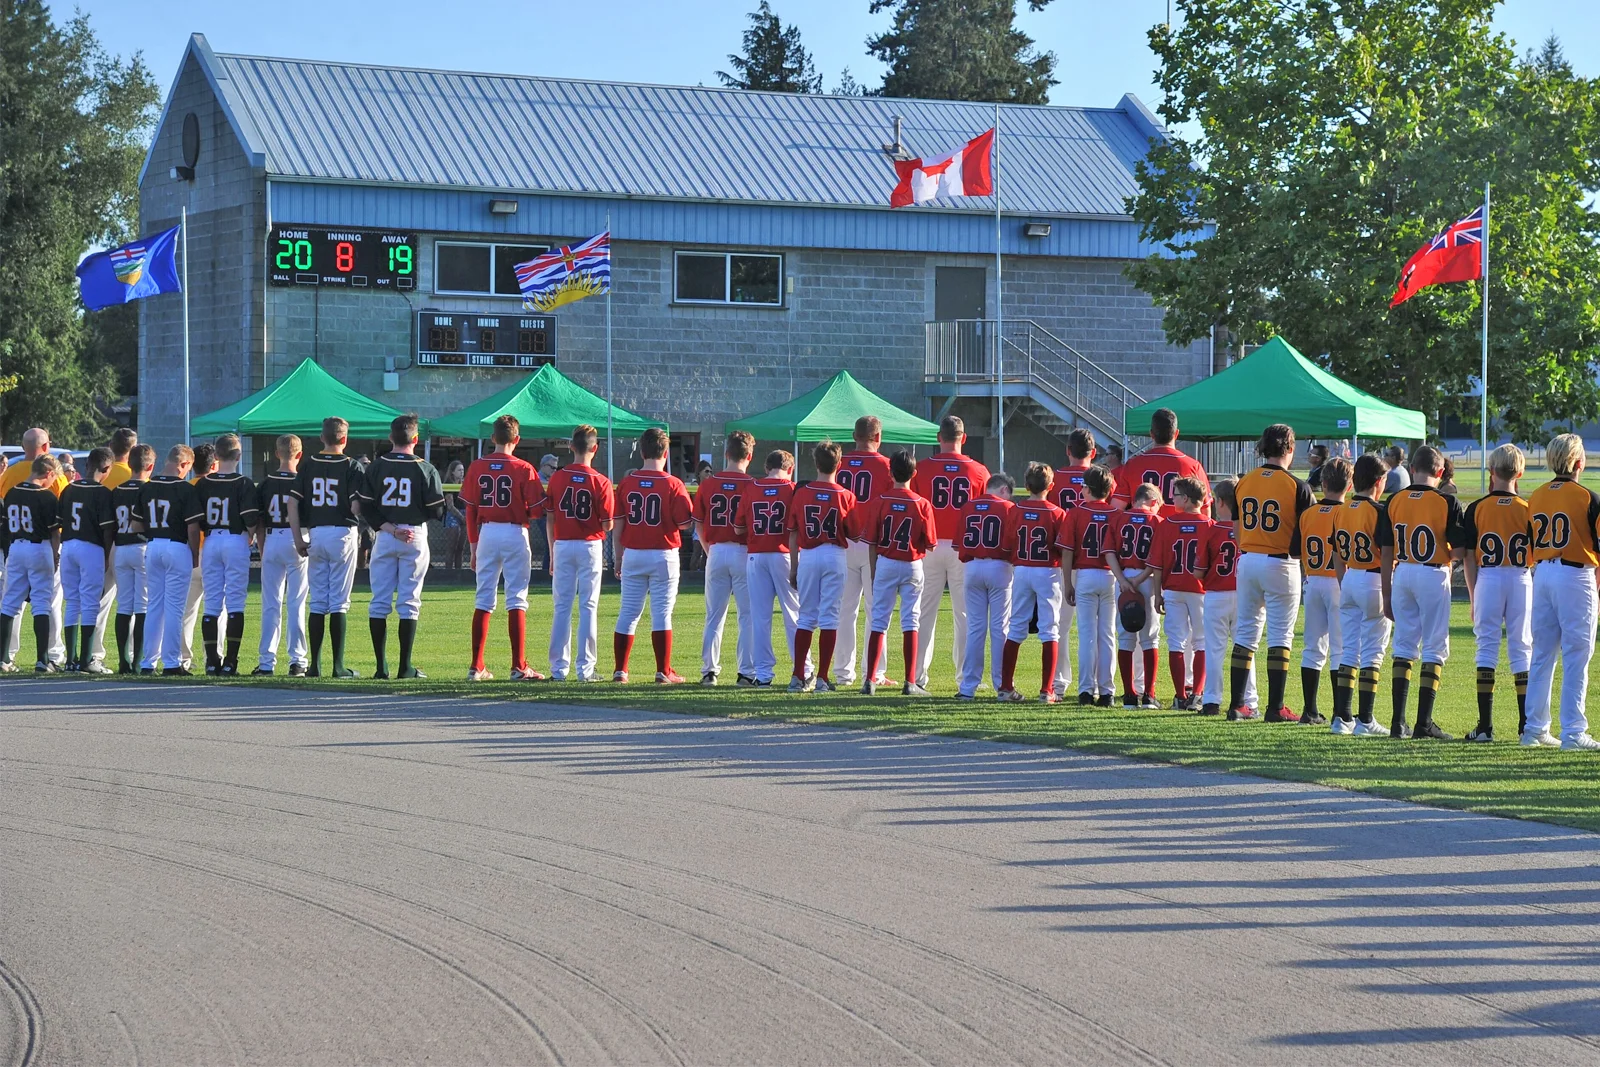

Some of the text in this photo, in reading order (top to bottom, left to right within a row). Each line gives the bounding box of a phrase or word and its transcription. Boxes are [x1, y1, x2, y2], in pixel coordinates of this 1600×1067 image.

[279, 231, 309, 239] HOME
[327, 233, 362, 242] INNING
[276, 240, 412, 274] 20 8 19
[434, 316, 545, 329] HOME INNING GUESTS
[421, 354, 533, 366] BALL STRIKE OUT
[311, 477, 339, 507] 95
[381, 476, 412, 508] 29
[478, 474, 513, 508] 26
[559, 486, 592, 521] 48
[931, 475, 971, 510] 66
[7, 504, 34, 533] 88
[71, 502, 84, 531] 5
[148, 499, 171, 528] 17
[206, 497, 230, 526] 61
[626, 491, 662, 527] 30
[752, 501, 787, 536] 52
[804, 504, 838, 540] 54
[1241, 497, 1281, 533] 86
[878, 514, 913, 552] 14
[963, 515, 1001, 549] 50
[1016, 525, 1050, 561] 12
[1120, 523, 1154, 560] 36
[1393, 523, 1437, 564] 10
[1532, 511, 1571, 550] 20
[1215, 540, 1241, 577] 3
[1479, 531, 1529, 568] 96
